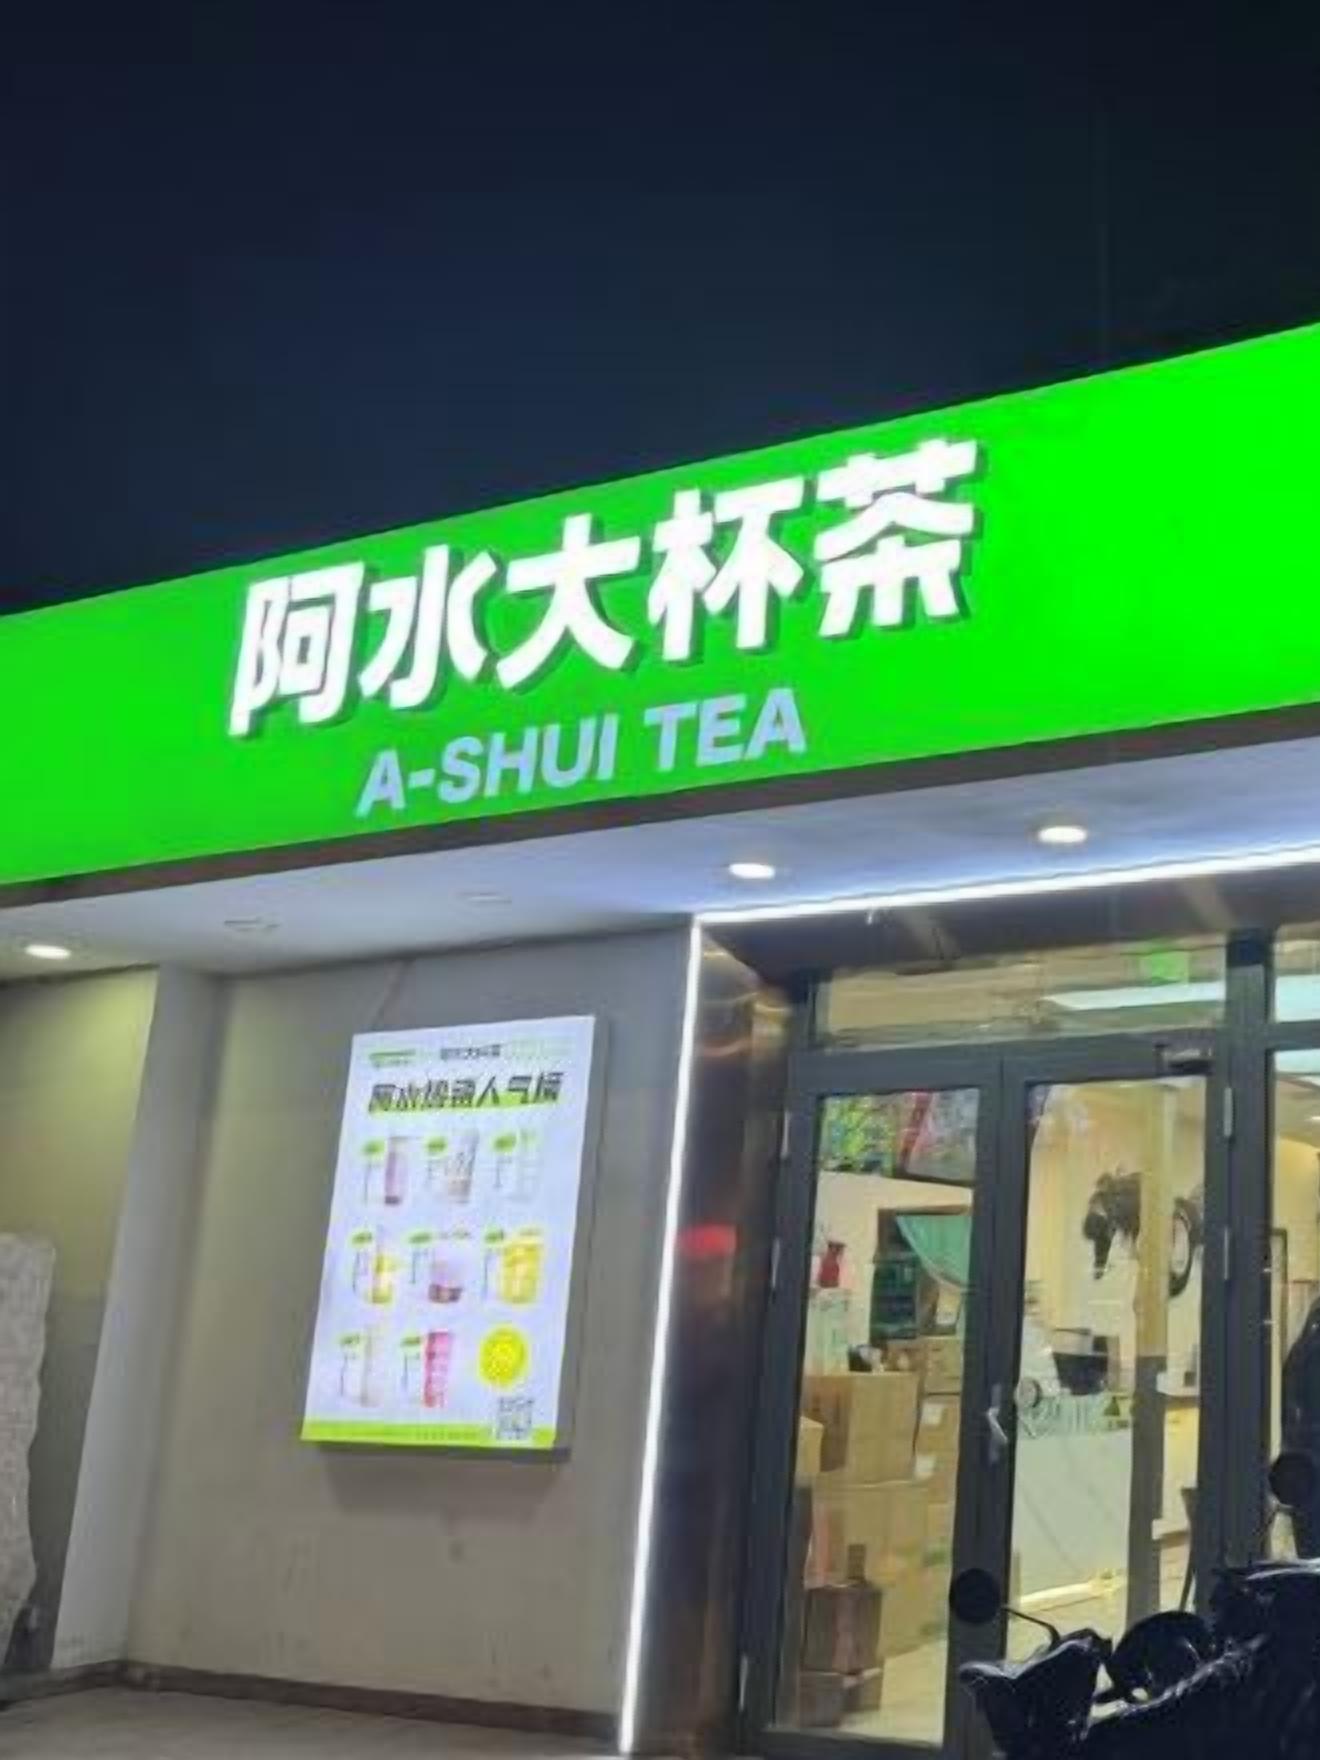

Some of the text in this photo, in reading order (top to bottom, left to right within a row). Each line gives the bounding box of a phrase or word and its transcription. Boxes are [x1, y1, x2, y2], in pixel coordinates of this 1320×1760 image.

[228, 438, 978, 736] 阿水大杯茶
[356, 686, 807, 818] A-SHUI TEA
